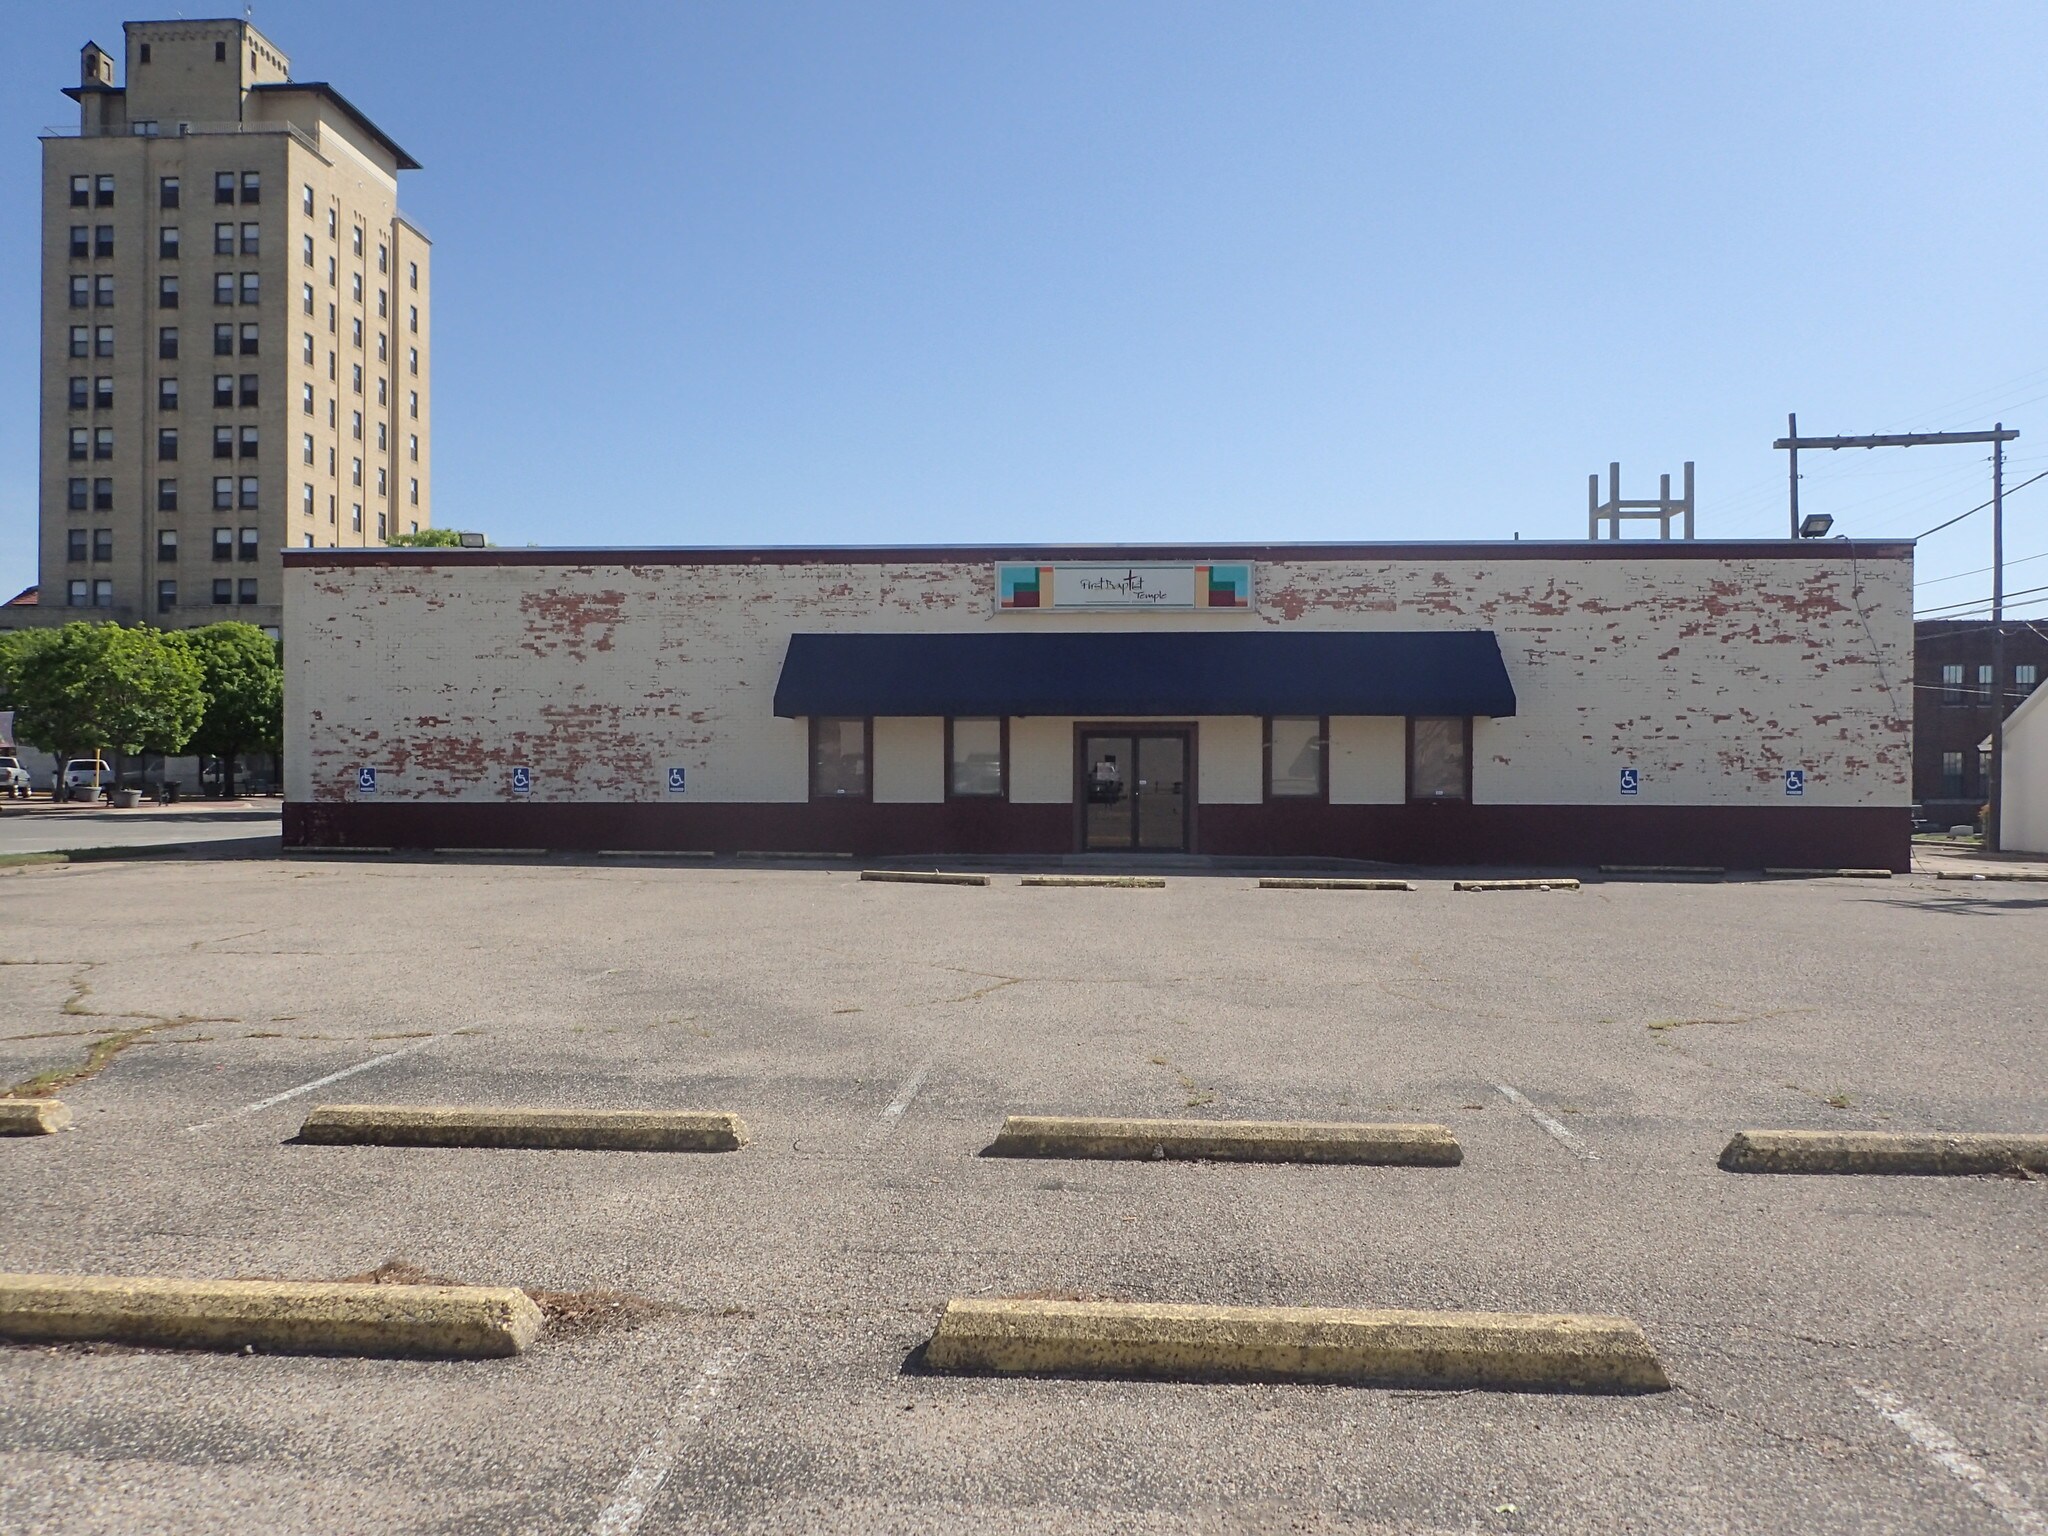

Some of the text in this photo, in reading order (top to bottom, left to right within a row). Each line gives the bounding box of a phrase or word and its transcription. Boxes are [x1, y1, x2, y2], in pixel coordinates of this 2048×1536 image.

[1080, 569, 1144, 595] First Baptist
[1133, 591, 1167, 603] Temple
